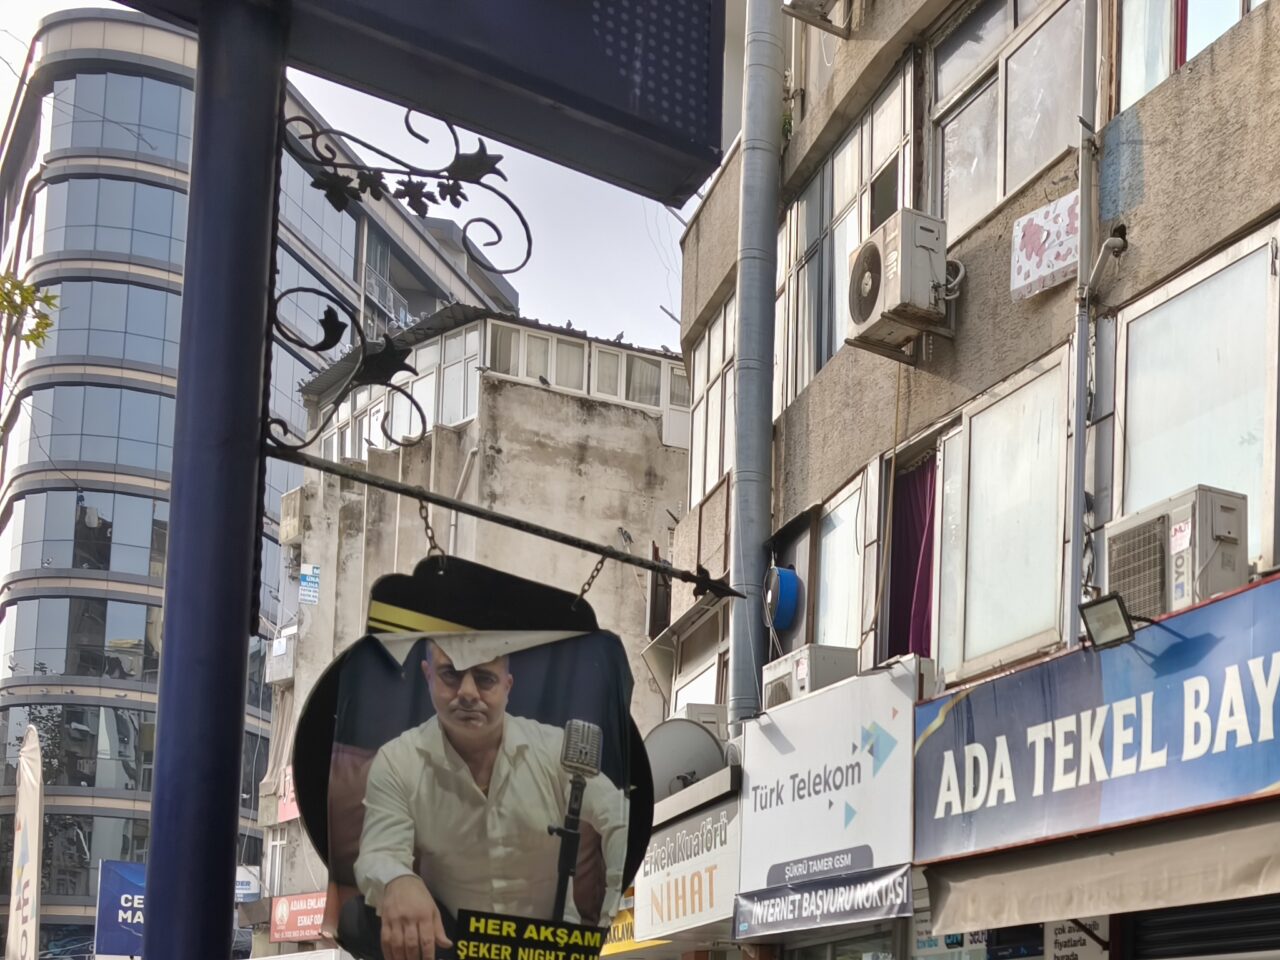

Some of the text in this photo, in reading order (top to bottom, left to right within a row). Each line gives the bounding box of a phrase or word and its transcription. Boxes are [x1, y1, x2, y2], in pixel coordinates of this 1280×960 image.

[934, 735, 1016, 820] ADA
[1026, 692, 1168, 797] TEKEL
[752, 761, 861, 812] Türk Telekom
[785, 853, 852, 881] ŞÜKRÜ TAMER GSM
[651, 864, 718, 926] NİHAT
[751, 876, 908, 925] İNTERNET BAŞVURU NOKTASI
[457, 940, 512, 960] ŞEKER
[469, 917, 601, 947] HER AKŞAM
